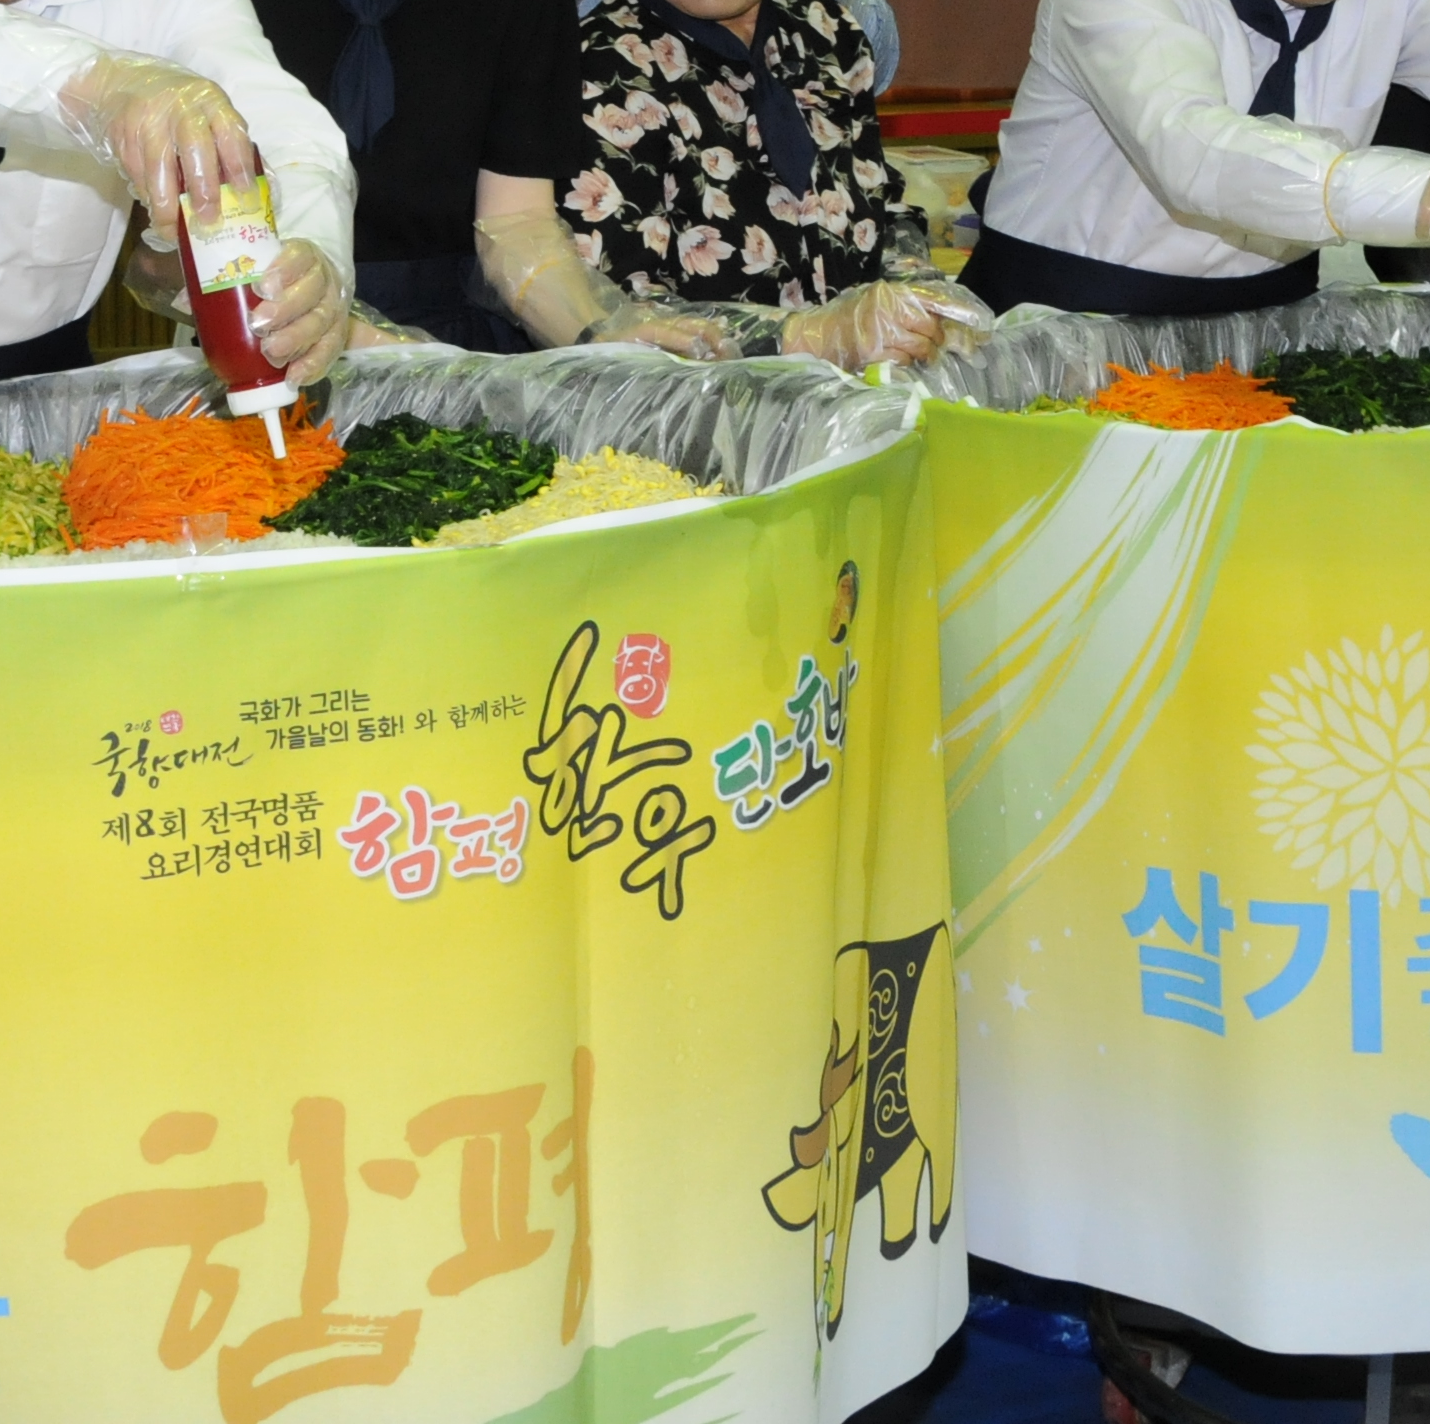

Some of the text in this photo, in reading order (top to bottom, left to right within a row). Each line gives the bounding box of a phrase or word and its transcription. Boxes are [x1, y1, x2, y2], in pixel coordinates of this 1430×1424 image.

[239, 688, 371, 724] 국화가 그리는
[265, 693, 527, 750] 가을날의 동화! 와 함께하는
[91, 730, 254, 798] 국향대전
[338, 785, 529, 899] 함평
[523, 619, 717, 921] 한우
[102, 790, 325, 847] 제8회 전국명품
[139, 826, 322, 880] 요리경연대회
